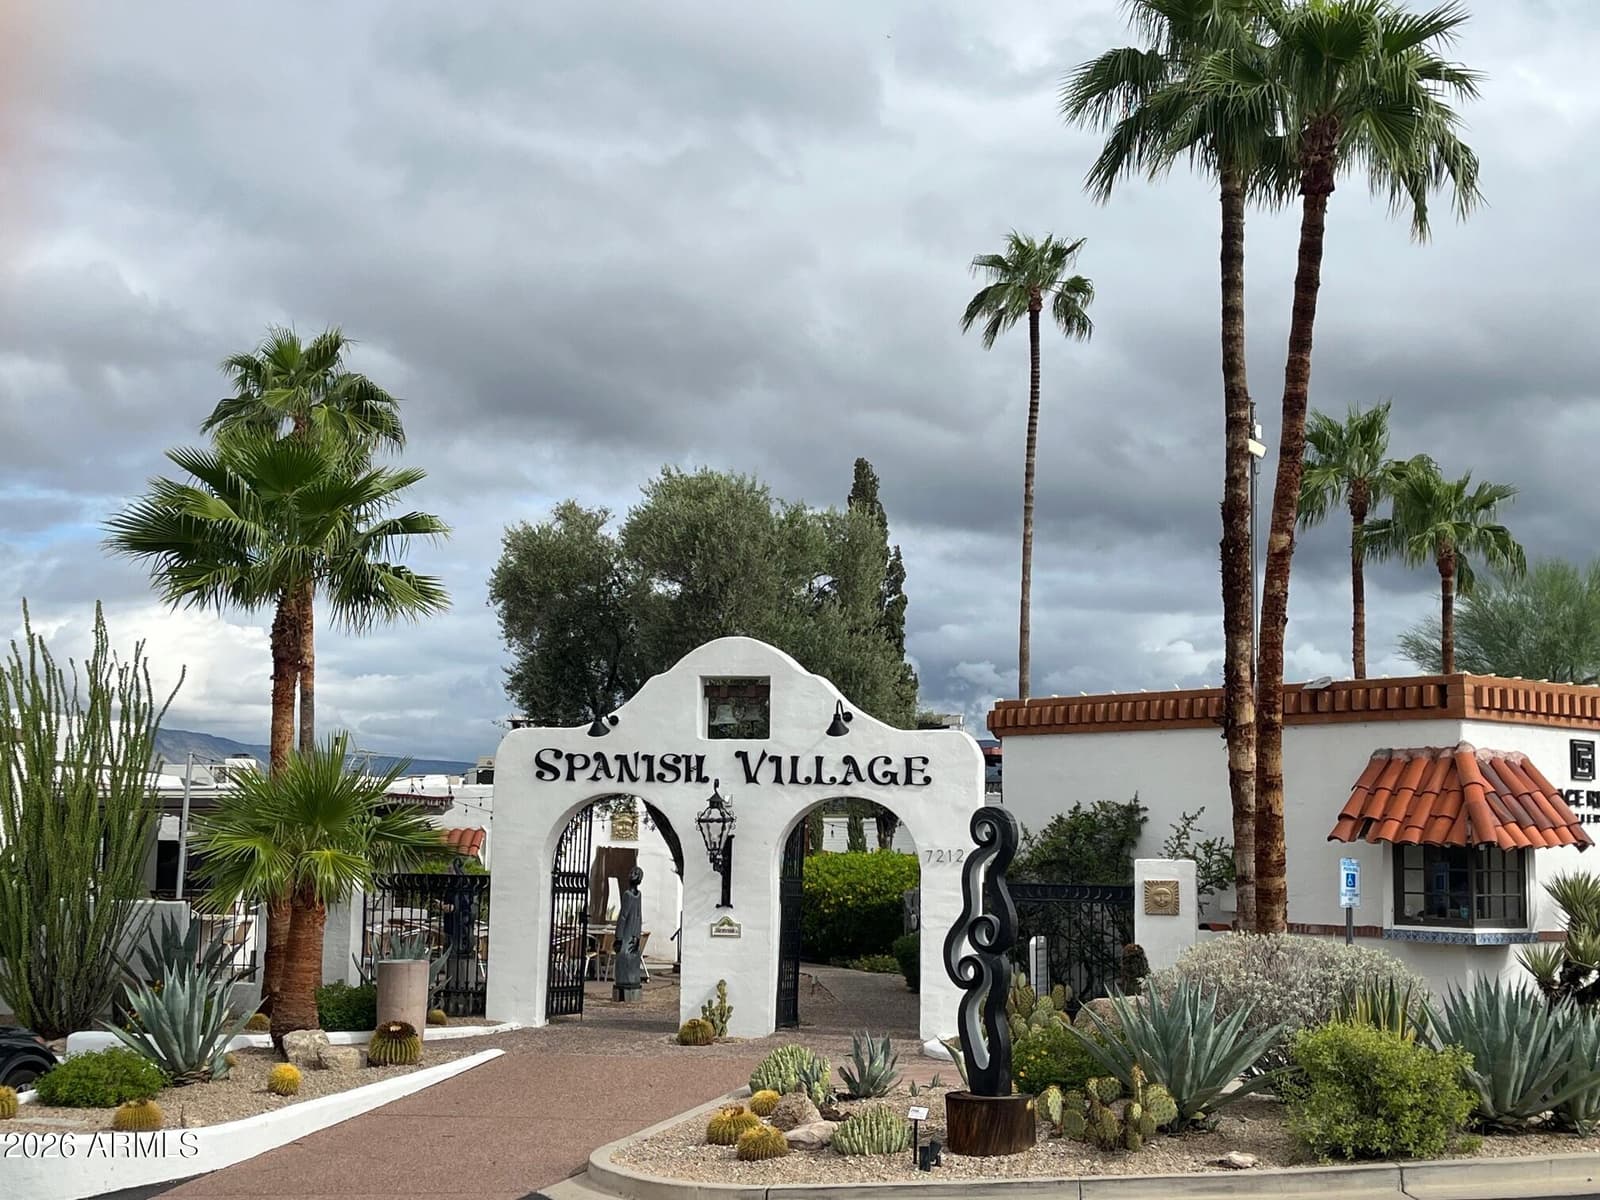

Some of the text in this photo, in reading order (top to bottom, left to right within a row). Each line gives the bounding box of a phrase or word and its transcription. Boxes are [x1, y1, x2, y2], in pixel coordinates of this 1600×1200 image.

[534, 748, 932, 786] SPANISH VILLAGE
[925, 848, 964, 864] 7212
